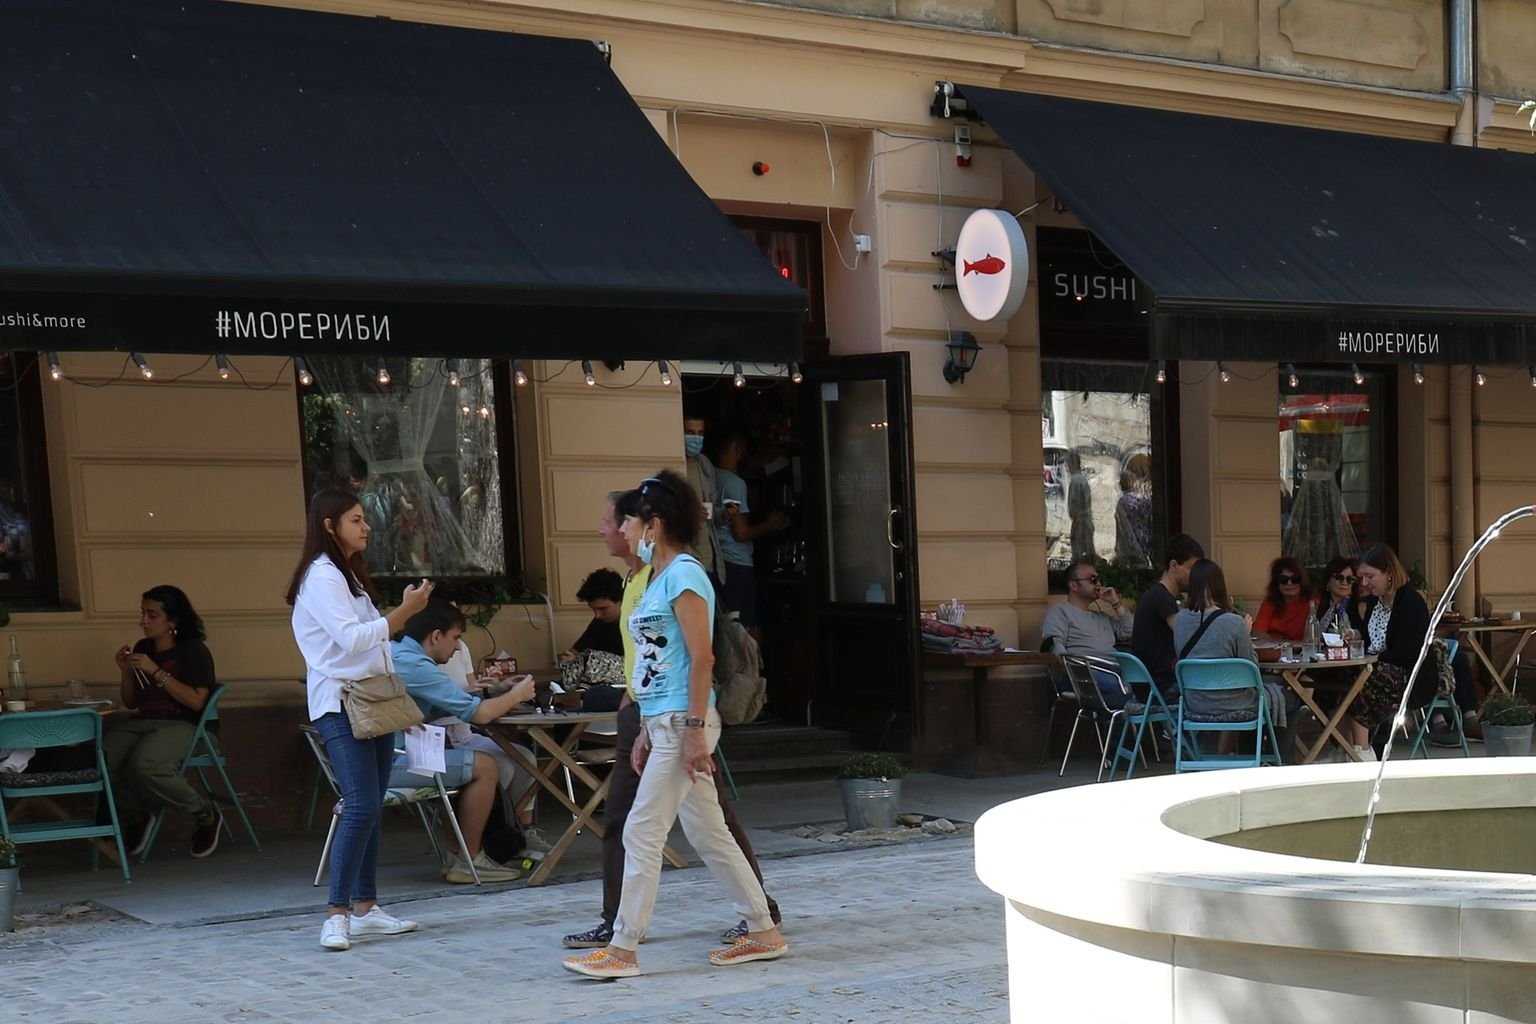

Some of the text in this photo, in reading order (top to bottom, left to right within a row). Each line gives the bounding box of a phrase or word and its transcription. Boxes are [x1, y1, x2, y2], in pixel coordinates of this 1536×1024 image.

[1055, 273, 1136, 301] SUSHI
[0, 312, 86, 328] ushi&more
[215, 310, 391, 342] #МОРЕРИБИ
[1338, 331, 1439, 354] #МОРЕРИБИ
